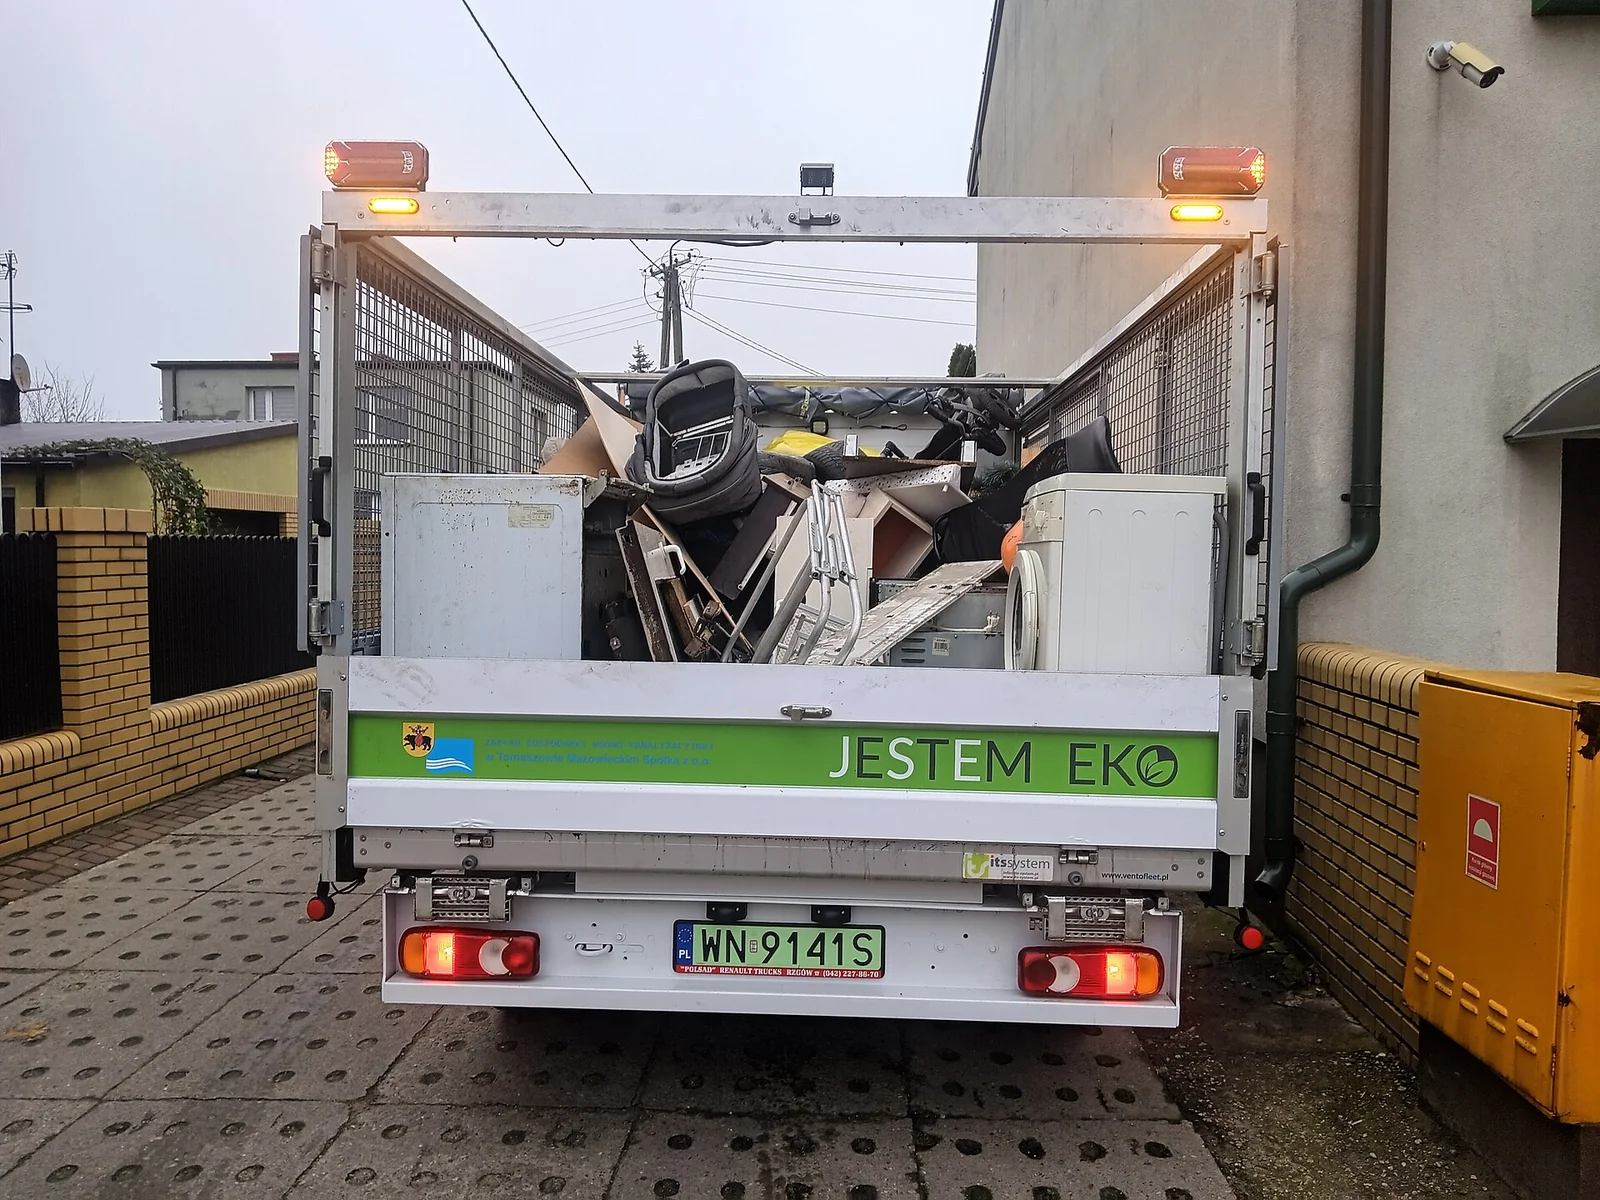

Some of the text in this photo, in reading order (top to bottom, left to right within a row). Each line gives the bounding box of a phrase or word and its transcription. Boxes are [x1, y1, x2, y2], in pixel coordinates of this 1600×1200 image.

[829, 735, 1179, 788] JESTEM EKO
[1101, 871, 1170, 882] www.ventofleet.pl
[701, 928, 873, 967] WN 9141S
[678, 949, 691, 960] PL
[719, 966, 752, 975] RENAULT
[754, 968, 782, 976] TRUCKS
[786, 967, 813, 977] RZGÓW
[822, 969, 842, 978] (042)
